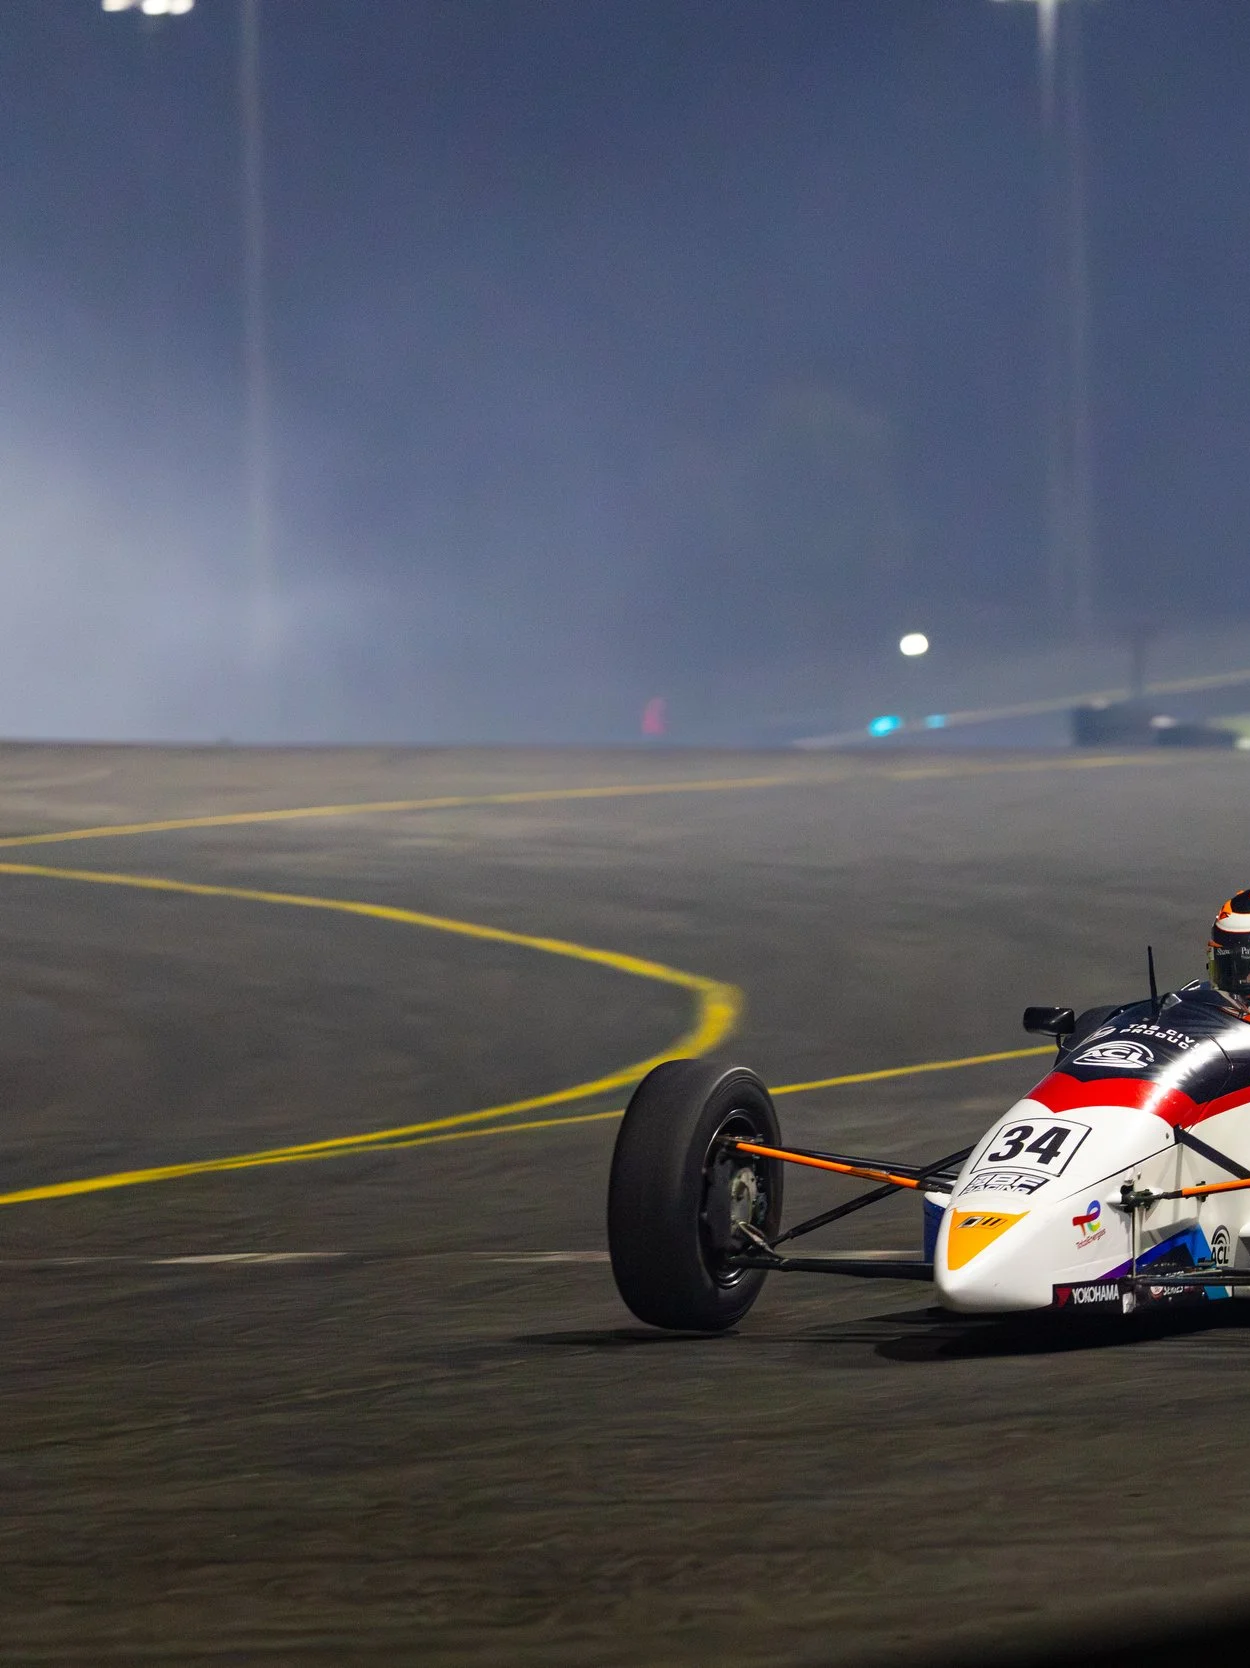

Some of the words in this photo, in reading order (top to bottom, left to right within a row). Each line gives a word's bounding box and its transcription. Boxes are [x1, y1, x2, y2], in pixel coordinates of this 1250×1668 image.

[1128, 1023, 1161, 1032] TAS
[1119, 1028, 1195, 1050] PRODUC
[988, 1125, 1071, 1165] 34
[961, 1184, 1032, 1195] RACING
[1210, 1246, 1229, 1265] ACL
[1072, 1284, 1120, 1304] YOKOHAMA
